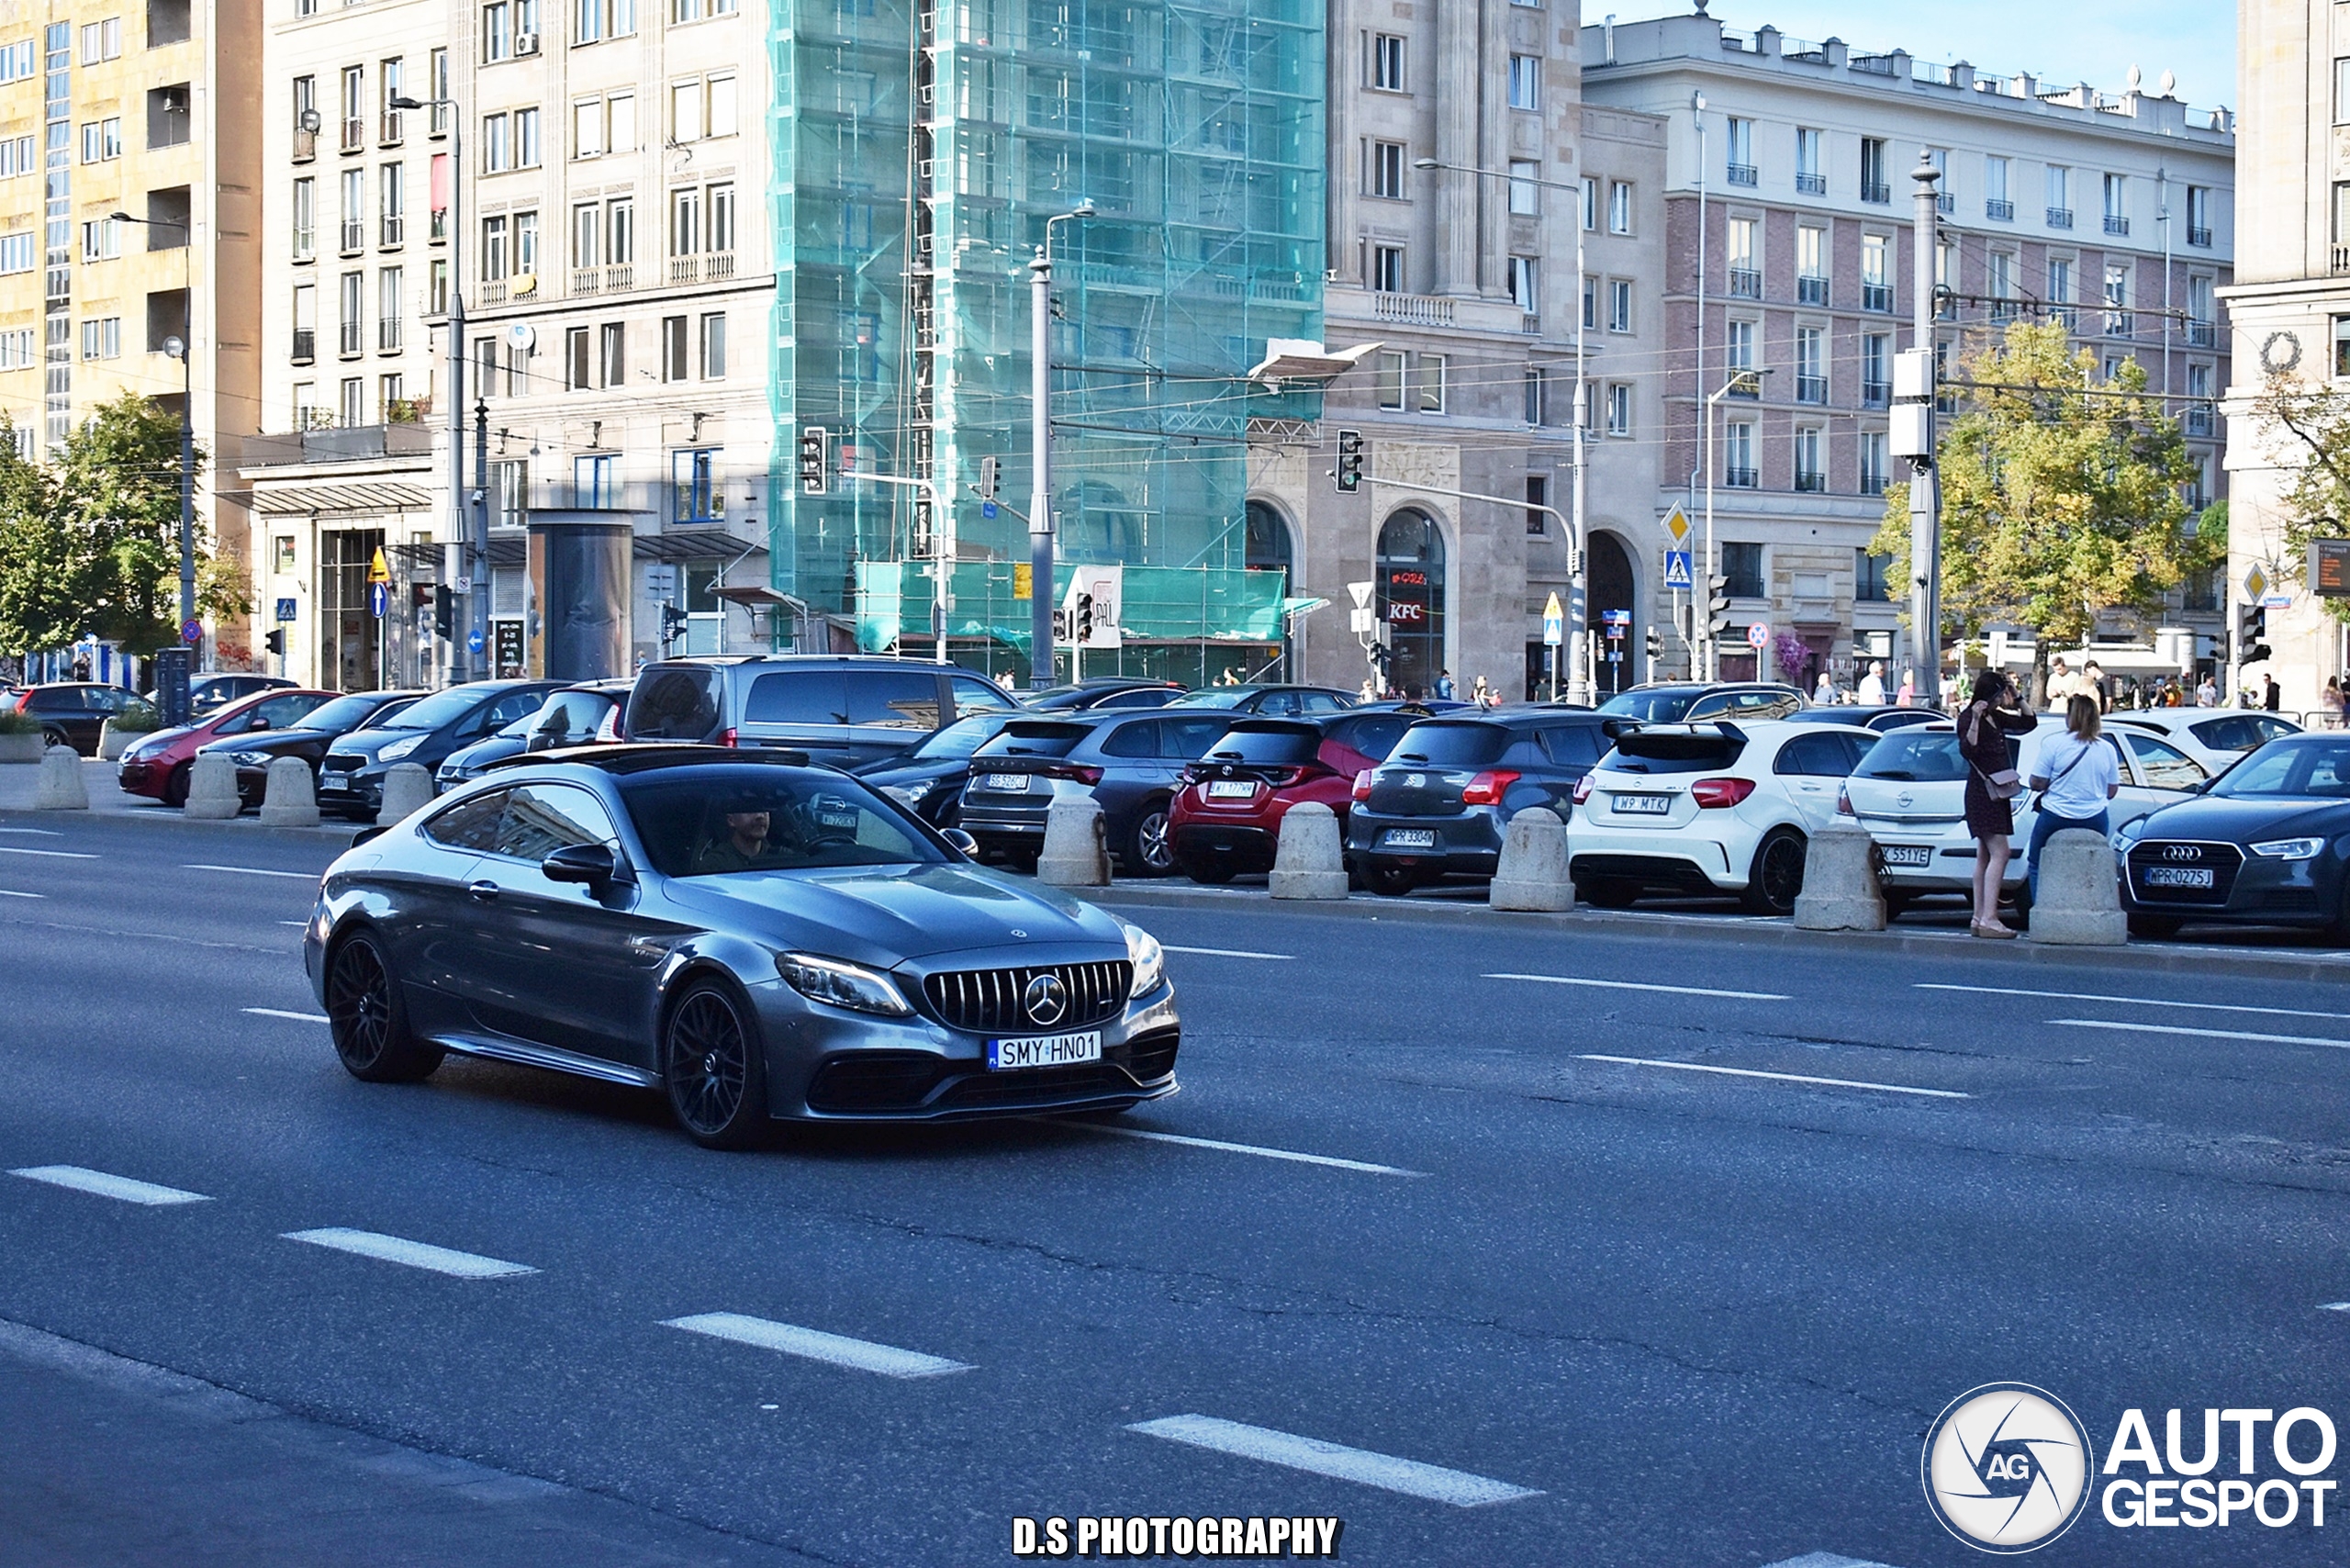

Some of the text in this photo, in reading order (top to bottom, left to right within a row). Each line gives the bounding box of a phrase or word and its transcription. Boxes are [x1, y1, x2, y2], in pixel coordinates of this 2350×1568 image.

[1389, 603, 1421, 620] KFC
[1620, 797, 1665, 811] W9 MTK
[1390, 830, 1406, 843] WPR
[1893, 847, 1928, 863] 551YE
[2150, 868, 2211, 885] WPR 0275J
[1002, 1034, 1094, 1066] SMY HN01
